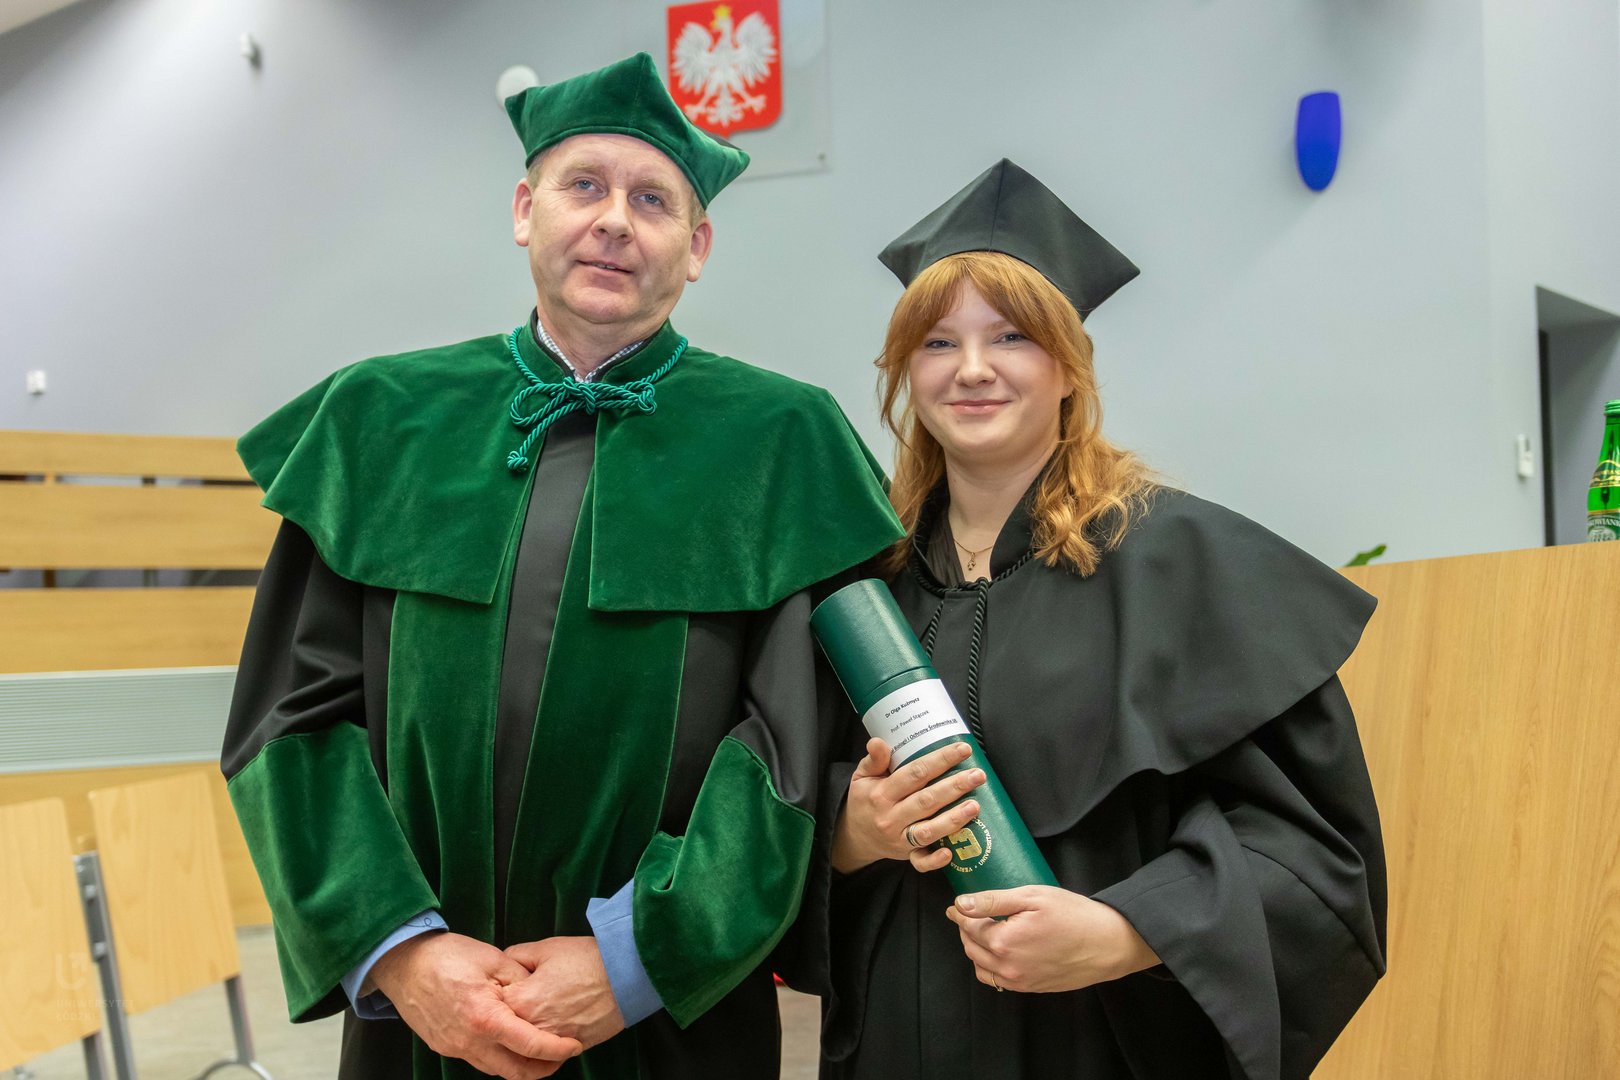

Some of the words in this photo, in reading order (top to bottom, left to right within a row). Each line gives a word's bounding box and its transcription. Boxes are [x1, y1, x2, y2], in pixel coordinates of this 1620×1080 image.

[890, 706, 901, 715] Olga
[900, 717, 913, 727] Paweł
[909, 728, 929, 741] Ochrony
